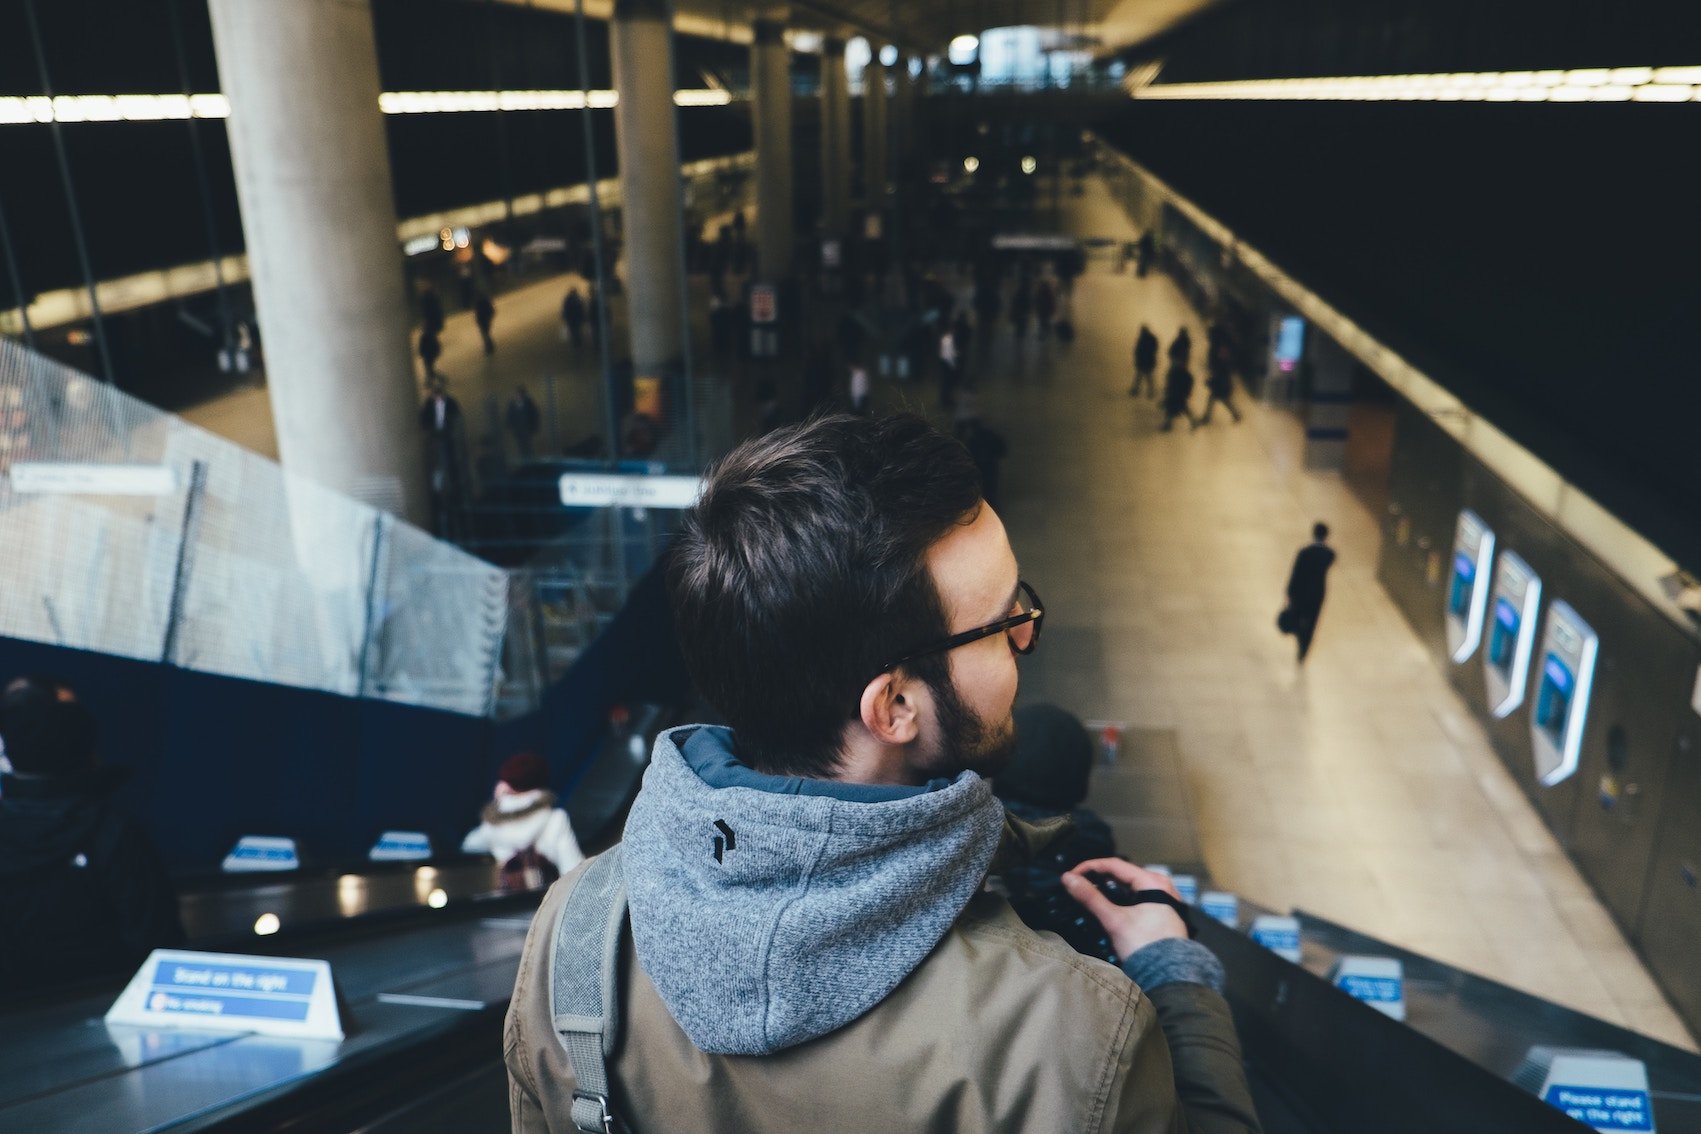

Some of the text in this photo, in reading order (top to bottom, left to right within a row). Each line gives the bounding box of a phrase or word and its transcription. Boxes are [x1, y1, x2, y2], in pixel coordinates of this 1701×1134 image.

[174, 967, 288, 992] Stand on the right
[1559, 1091, 1642, 1109] Please stand
[1586, 1108, 1610, 1121] the
[1612, 1110, 1643, 1125] right
